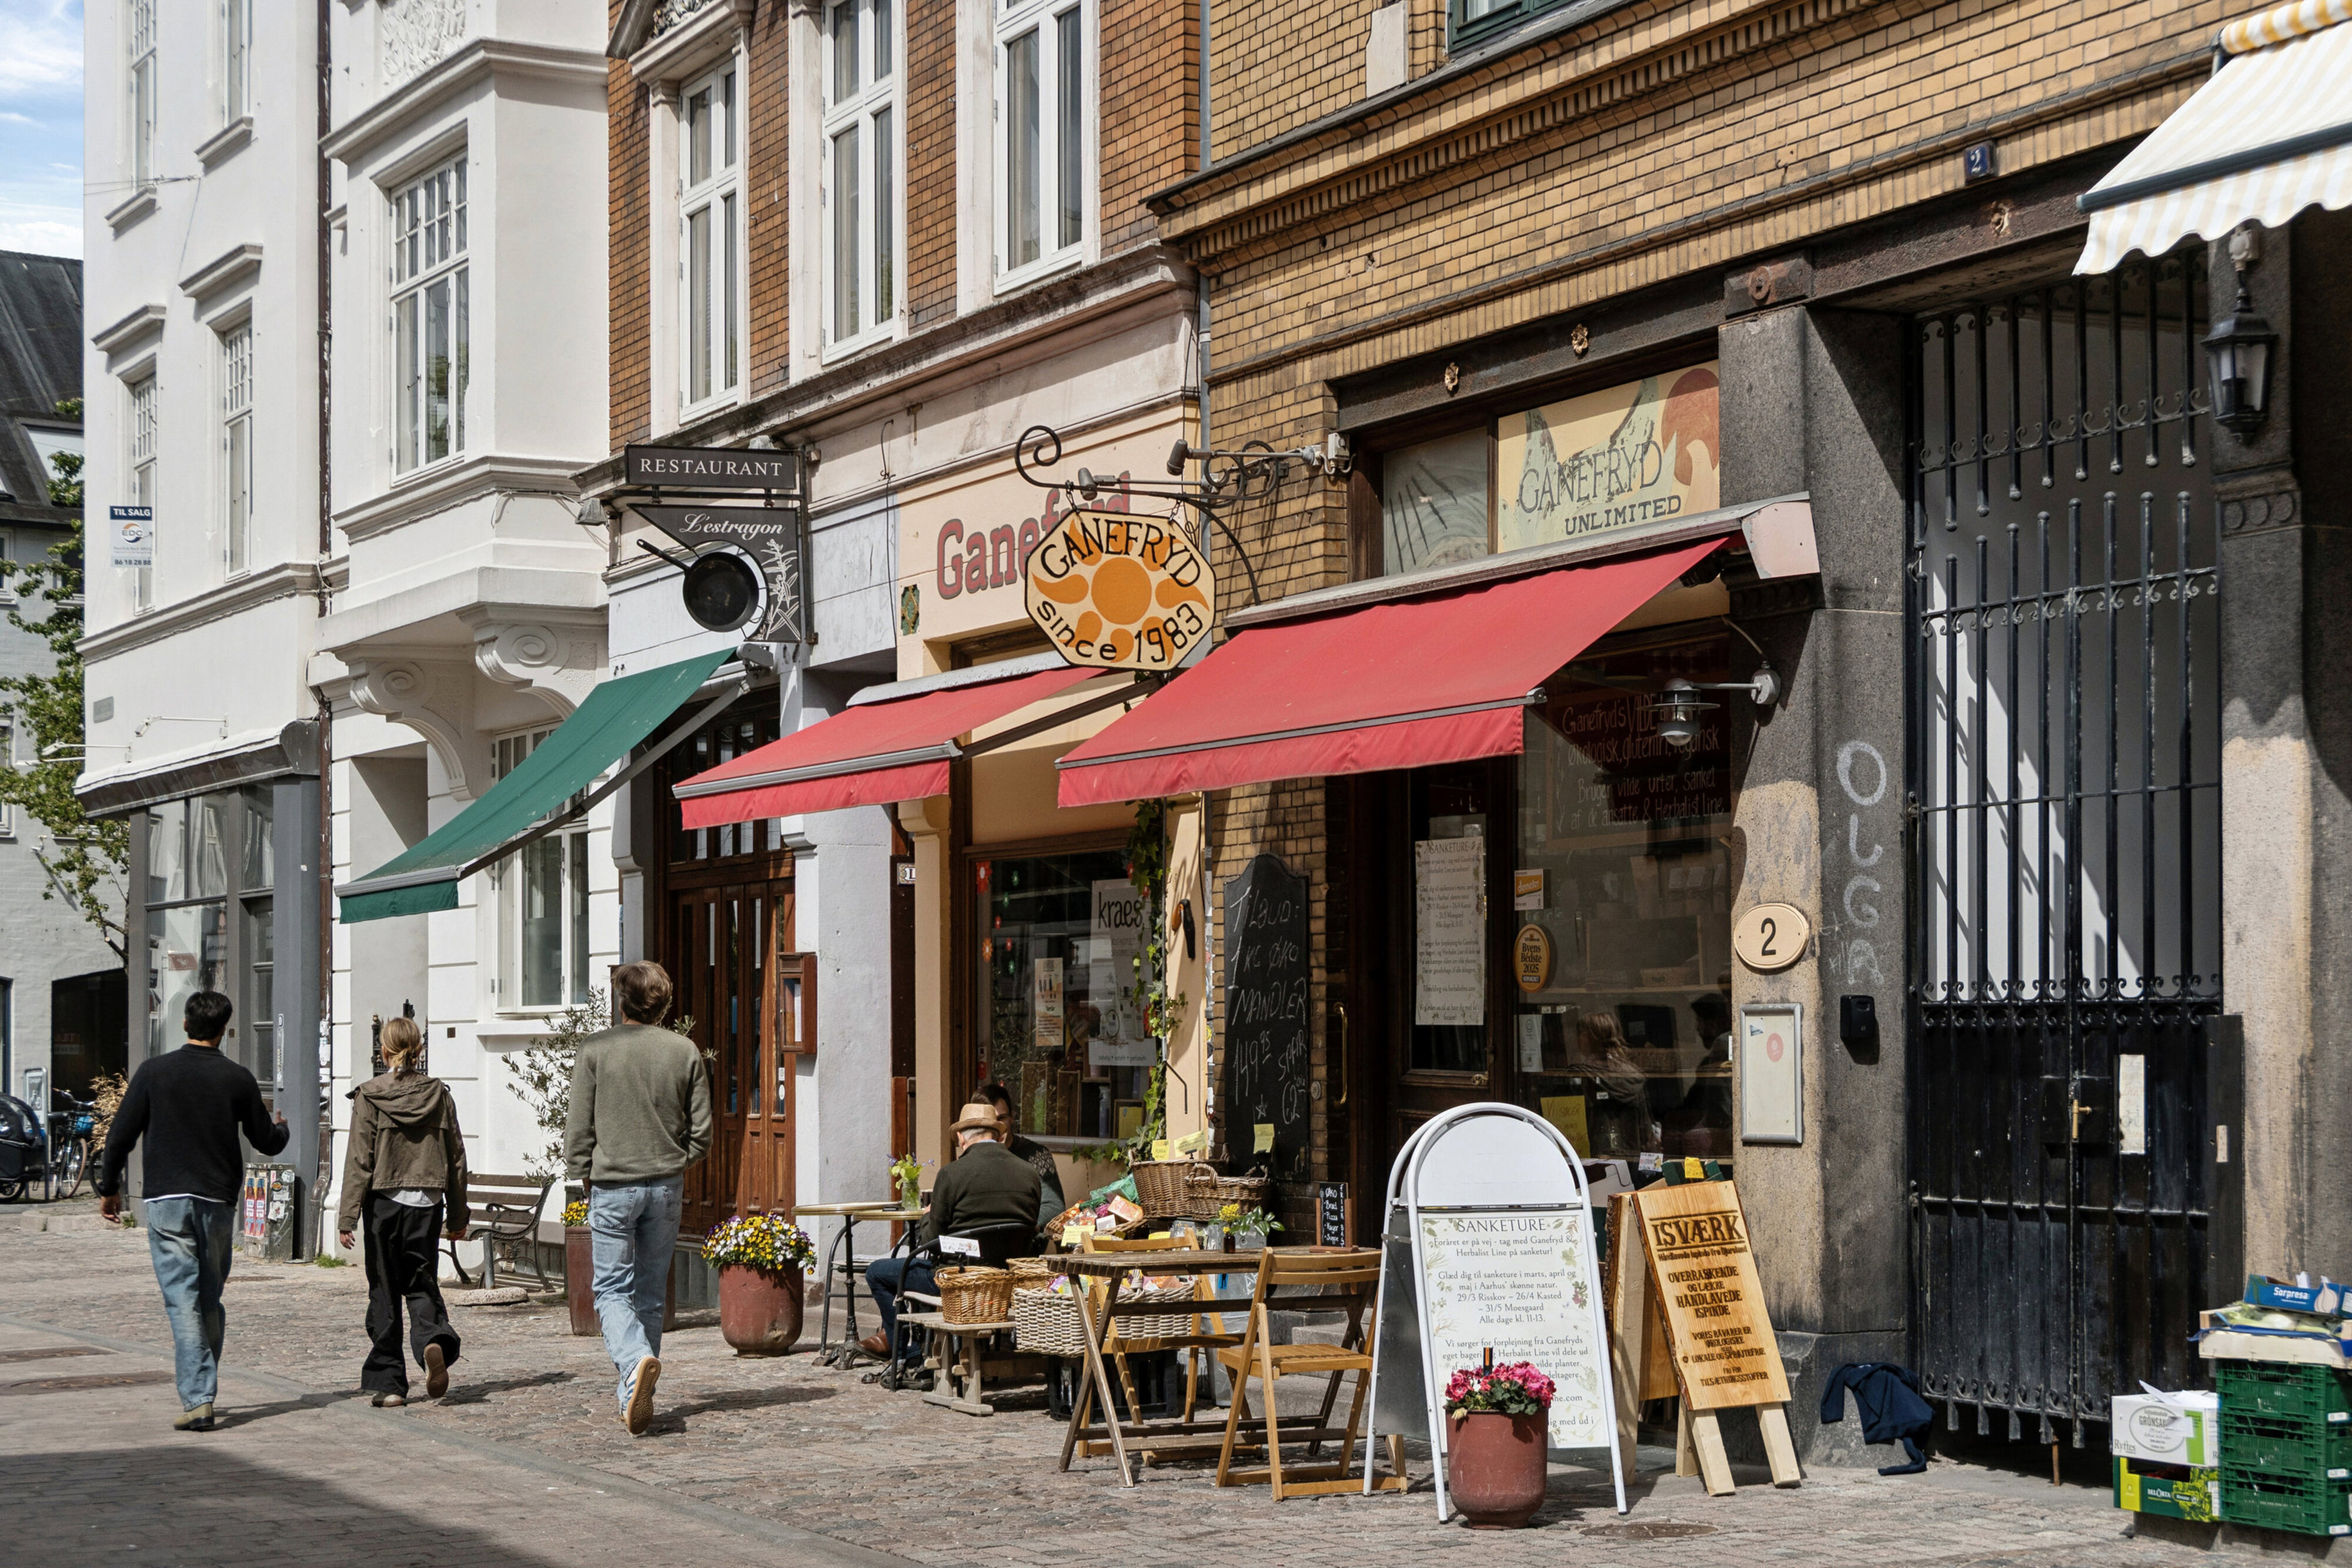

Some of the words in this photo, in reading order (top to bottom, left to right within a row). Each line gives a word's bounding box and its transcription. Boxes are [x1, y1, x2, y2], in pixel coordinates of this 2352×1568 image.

[1970, 149, 1981, 173] 2
[640, 459, 782, 476] RESTAURANT
[1518, 440, 1662, 513] GANEFRYD
[1565, 494, 1681, 535] UNLIMITED
[680, 513, 785, 540] L'estragon
[1040, 517, 1201, 588] GANEFRYD
[1037, 601, 1117, 660] since
[1135, 603, 1203, 663] 1983
[1578, 778, 1613, 807] Bruger
[1617, 776, 1640, 798] vilde
[1683, 765, 1716, 791] sanket
[1571, 809, 1581, 830] af
[1602, 803, 1638, 827] ansatte
[1642, 797, 1651, 824] &
[1654, 794, 1700, 821] Herbalist
[1430, 841, 1468, 854] SANKETURE
[1518, 880, 1539, 892] demeter
[1098, 892, 1142, 929] kraes
[1760, 917, 1776, 956] 2
[1522, 943, 1541, 954] Byens
[1521, 953, 1542, 964] Bedste
[1523, 964, 1539, 973] 2025
[1232, 977, 1307, 1025] MANDLER
[1325, 1187, 1337, 1198] ØKO
[1326, 1212, 1338, 1221] Pizza
[1458, 1219, 1546, 1232] SANKETURE
[1652, 1215, 1744, 1246] ISVÆRK
[1434, 1238, 1460, 1246] Foråret
[1472, 1238, 1480, 1248] på
[1482, 1238, 1492, 1247] vej
[1499, 1238, 1511, 1247] tag
[1513, 1236, 1528, 1245] med
[1530, 1236, 1563, 1245] Ganefryd
[1456, 1248, 1489, 1256] Herbalist
[1509, 1248, 1518, 1257] på
[1438, 1271, 1458, 1279] Glæd
[1461, 1271, 1472, 1281] dig
[1484, 1270, 1518, 1278] sanketure
[1549, 1270, 1565, 1279] april
[1668, 1266, 1739, 1283] OVERRASKENDE
[1459, 1283, 1472, 1292] maj
[1688, 1284, 1697, 1292] OG
[1699, 1281, 1725, 1292] LÆKRE
[2274, 1286, 2309, 1299] Sorpresa
[1457, 1292, 1476, 1302] 29/3
[1478, 1292, 1506, 1301] Risskov
[1516, 1292, 1534, 1300] 26/4
[1537, 1291, 1562, 1299] Kasted
[1486, 1303, 1502, 1312] 31/5
[1505, 1303, 1544, 1313] Moesgaard
[1695, 1305, 1730, 1319] ISPINDE
[1479, 1315, 1495, 1323] Alle
[1498, 1315, 1513, 1325] dage
[1515, 1314, 1524, 1322] kl.
[1692, 1331, 1713, 1340] VORES
[1706, 1336, 1745, 1348] ØKOLOGISKE
[1456, 1340, 1478, 1349] sørger
[1481, 1338, 1491, 1347] for
[1494, 1337, 1532, 1348] forplejning
[1546, 1336, 1583, 1346] Ganefryds
[1460, 1350, 1482, 1359] bageri
[1498, 1349, 1532, 1357] Herbalist
[1534, 1348, 1549, 1356] Line
[1562, 1348, 1576, 1356] dele
[1692, 1354, 1716, 1363] LOKALE
[1451, 1362, 1458, 1370] af
[1700, 1372, 1769, 1386] TILSÆTNINGSSTOFFER
[1579, 1416, 1588, 1425] ud
[2114, 1439, 2136, 1452] Ryftes
